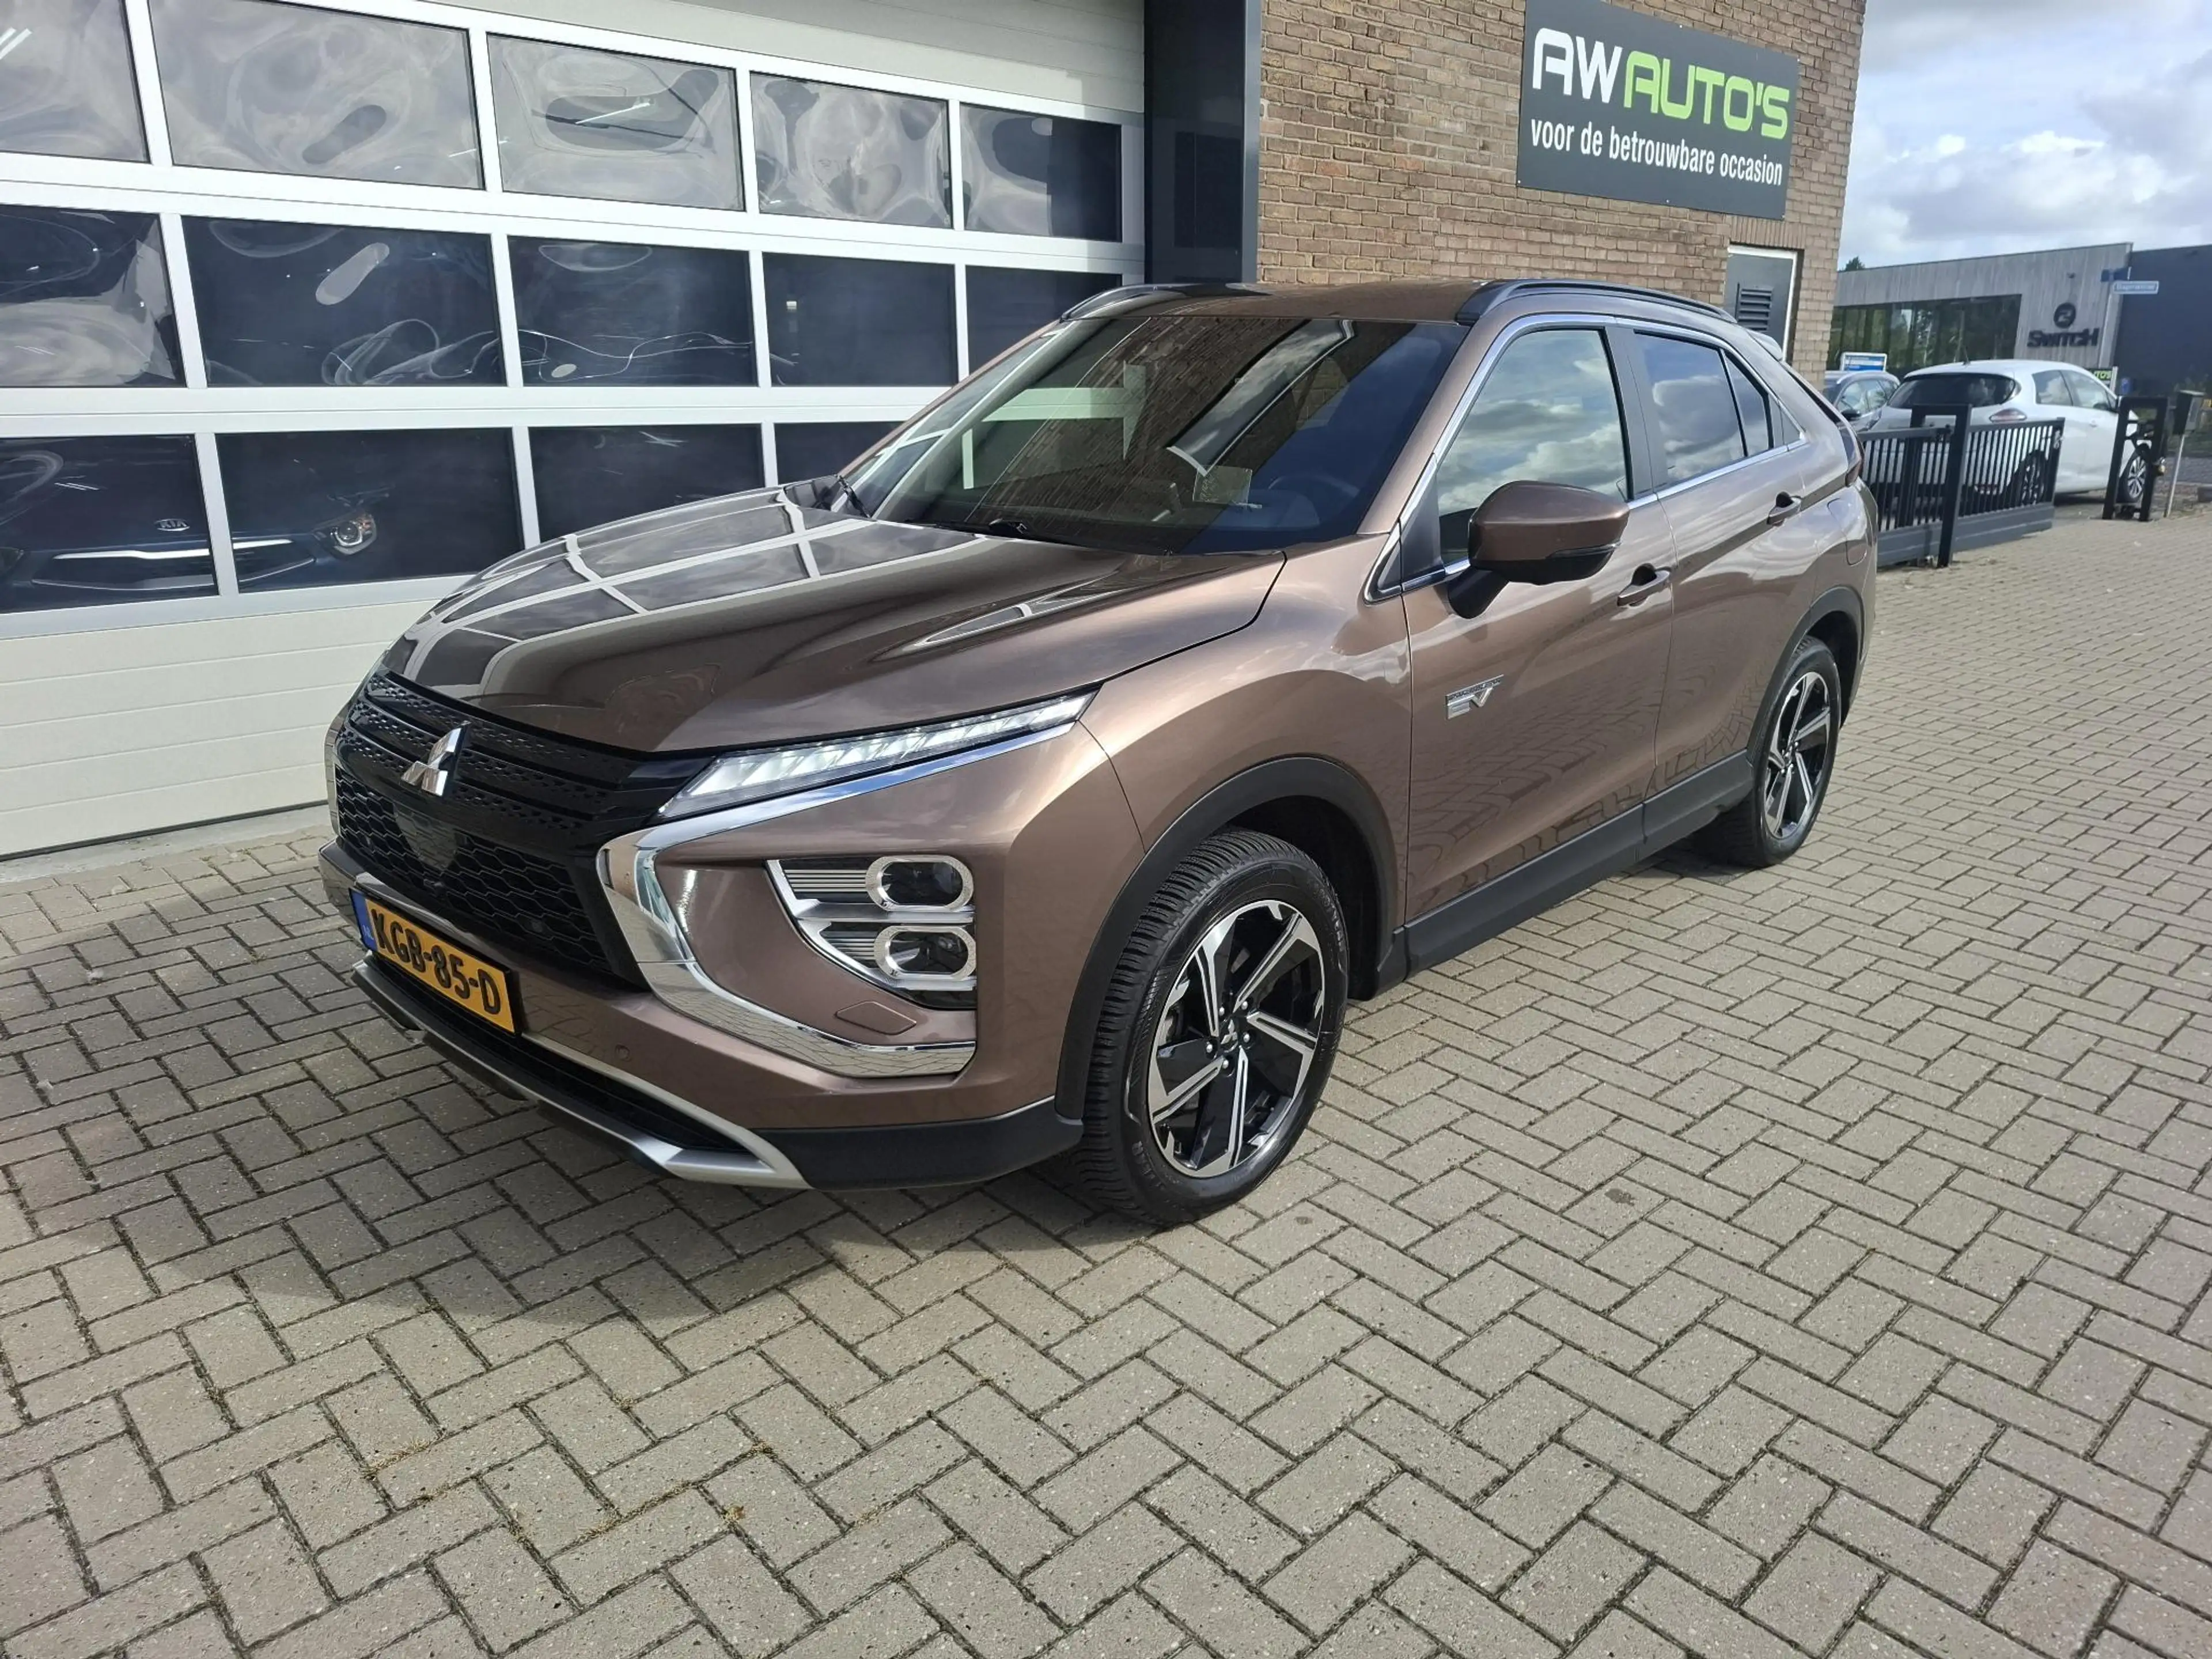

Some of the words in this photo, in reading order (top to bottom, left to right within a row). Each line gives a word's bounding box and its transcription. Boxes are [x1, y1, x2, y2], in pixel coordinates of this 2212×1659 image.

[1531, 119, 1574, 151] voor
[1580, 121, 1603, 157] de
[1609, 126, 1715, 174] betrouwbare
[1720, 153, 1783, 186] occasion
[371, 908, 501, 1015] KGB-85-D
